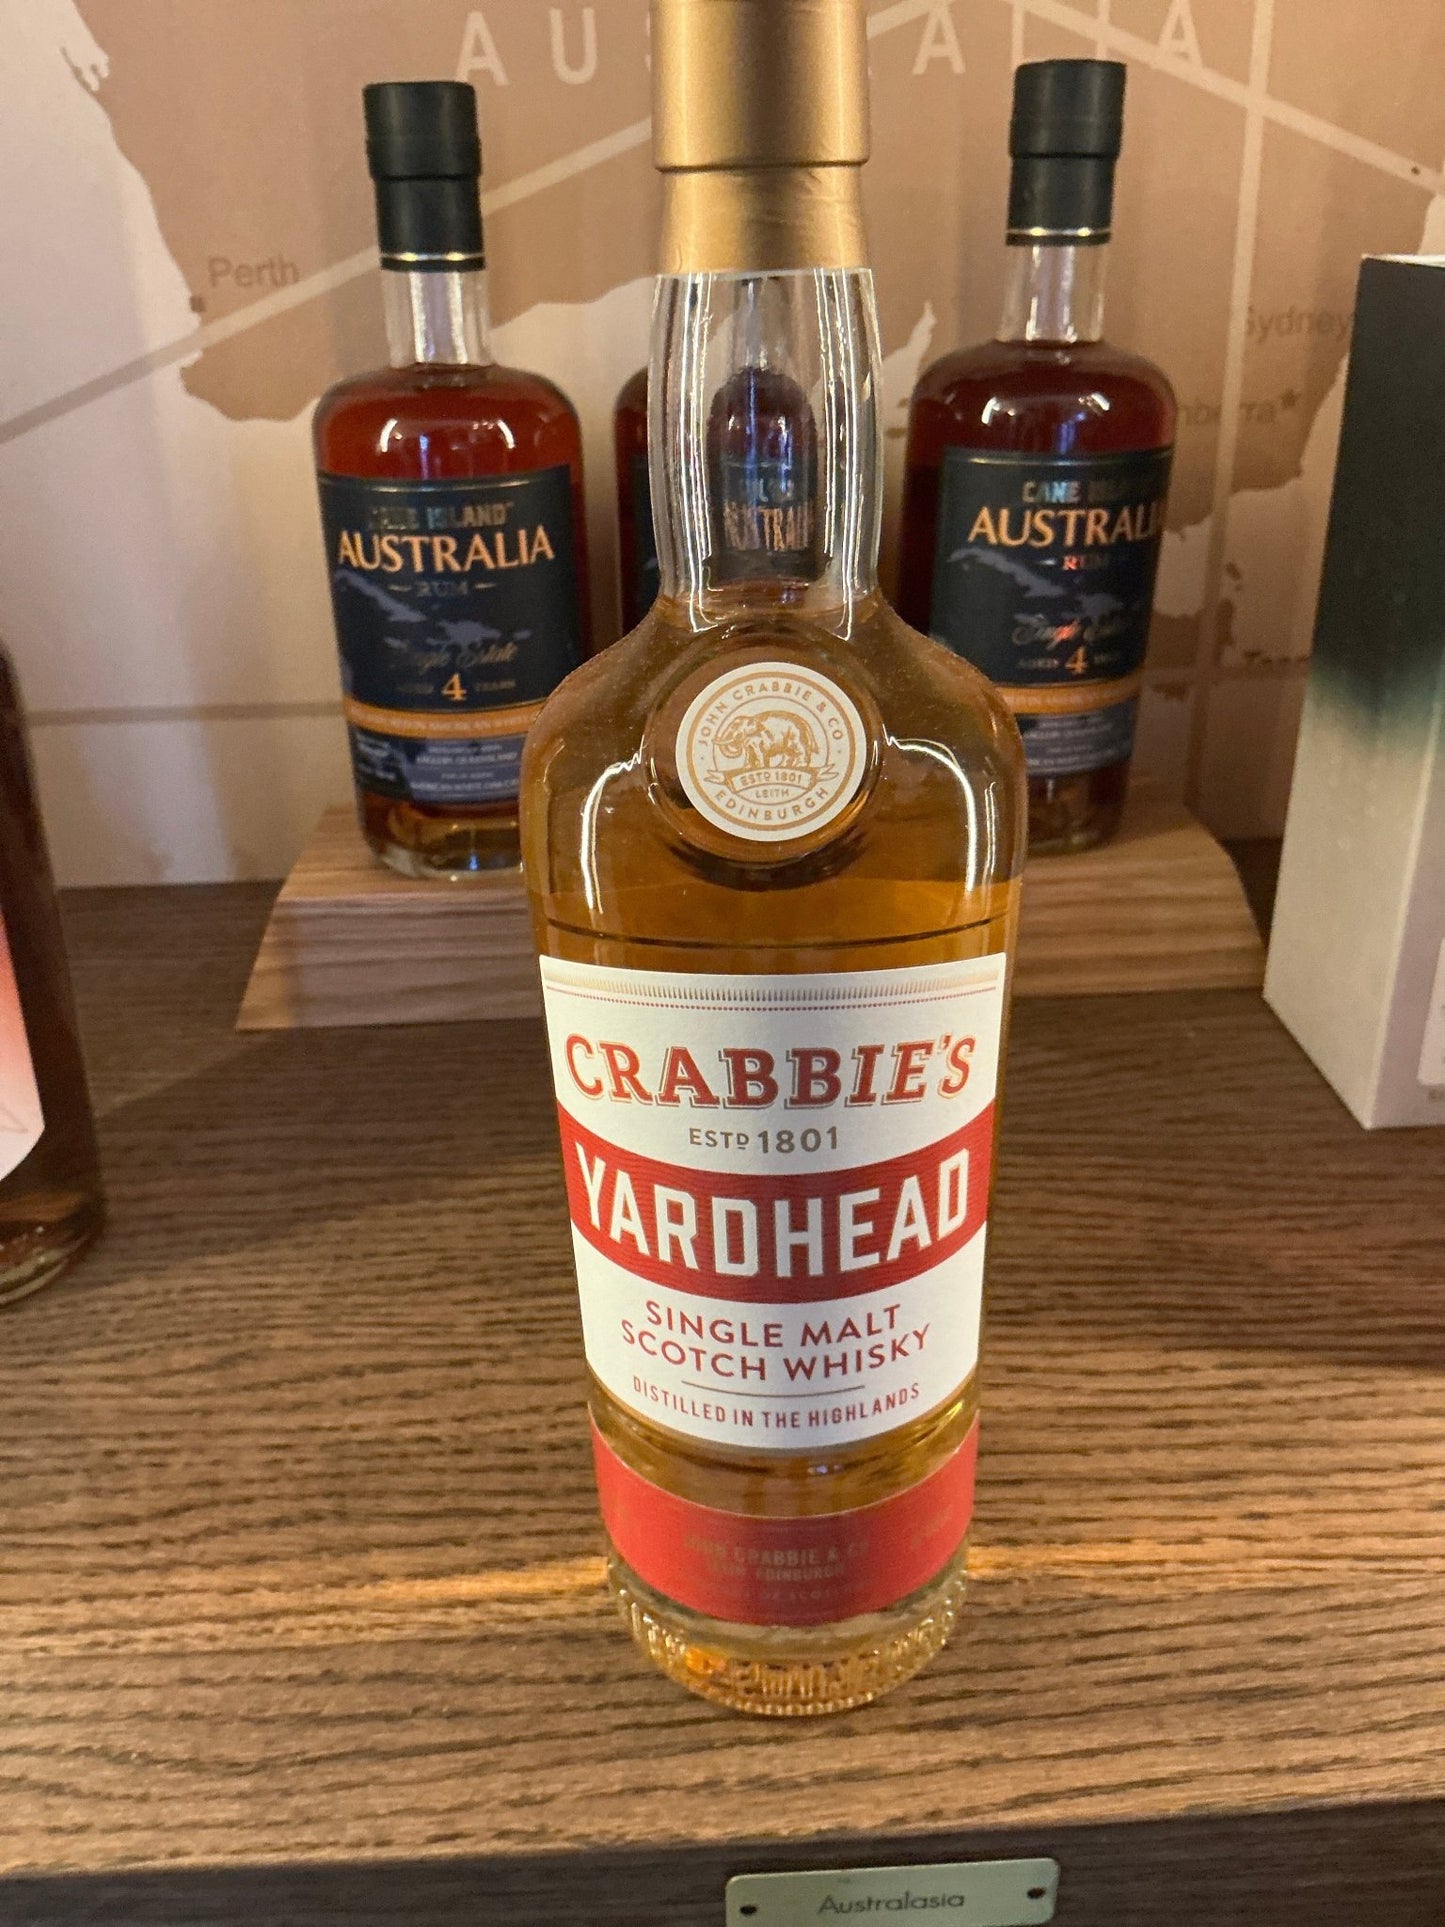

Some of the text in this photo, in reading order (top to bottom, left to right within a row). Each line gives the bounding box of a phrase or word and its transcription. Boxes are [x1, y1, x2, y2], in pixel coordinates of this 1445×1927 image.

[208, 255, 299, 289] Perth
[967, 499, 1161, 548] AUSTRALI
[338, 524, 556, 574] AUSTRALIA
[1065, 646, 1088, 674] 4
[441, 671, 468, 701] 4
[698, 701, 729, 747] JOHN
[732, 681, 813, 701] CRABBIE
[815, 701, 827, 713] &
[755, 788, 790, 799] LEITH
[775, 771, 803, 785] 1801
[715, 786, 829, 821] EDINBURGH
[565, 1032, 976, 1110] CRABBIE'S
[760, 1125, 839, 1154] 1801
[574, 1141, 971, 1278] YARDHEAD
[646, 1299, 901, 1348] SINGLE MALT
[621, 1318, 931, 1382] SCOTCH WHISKY
[632, 1374, 920, 1428] DISTILLED IN THE HIGHLANDS
[816, 1890, 966, 1915] Australasia
